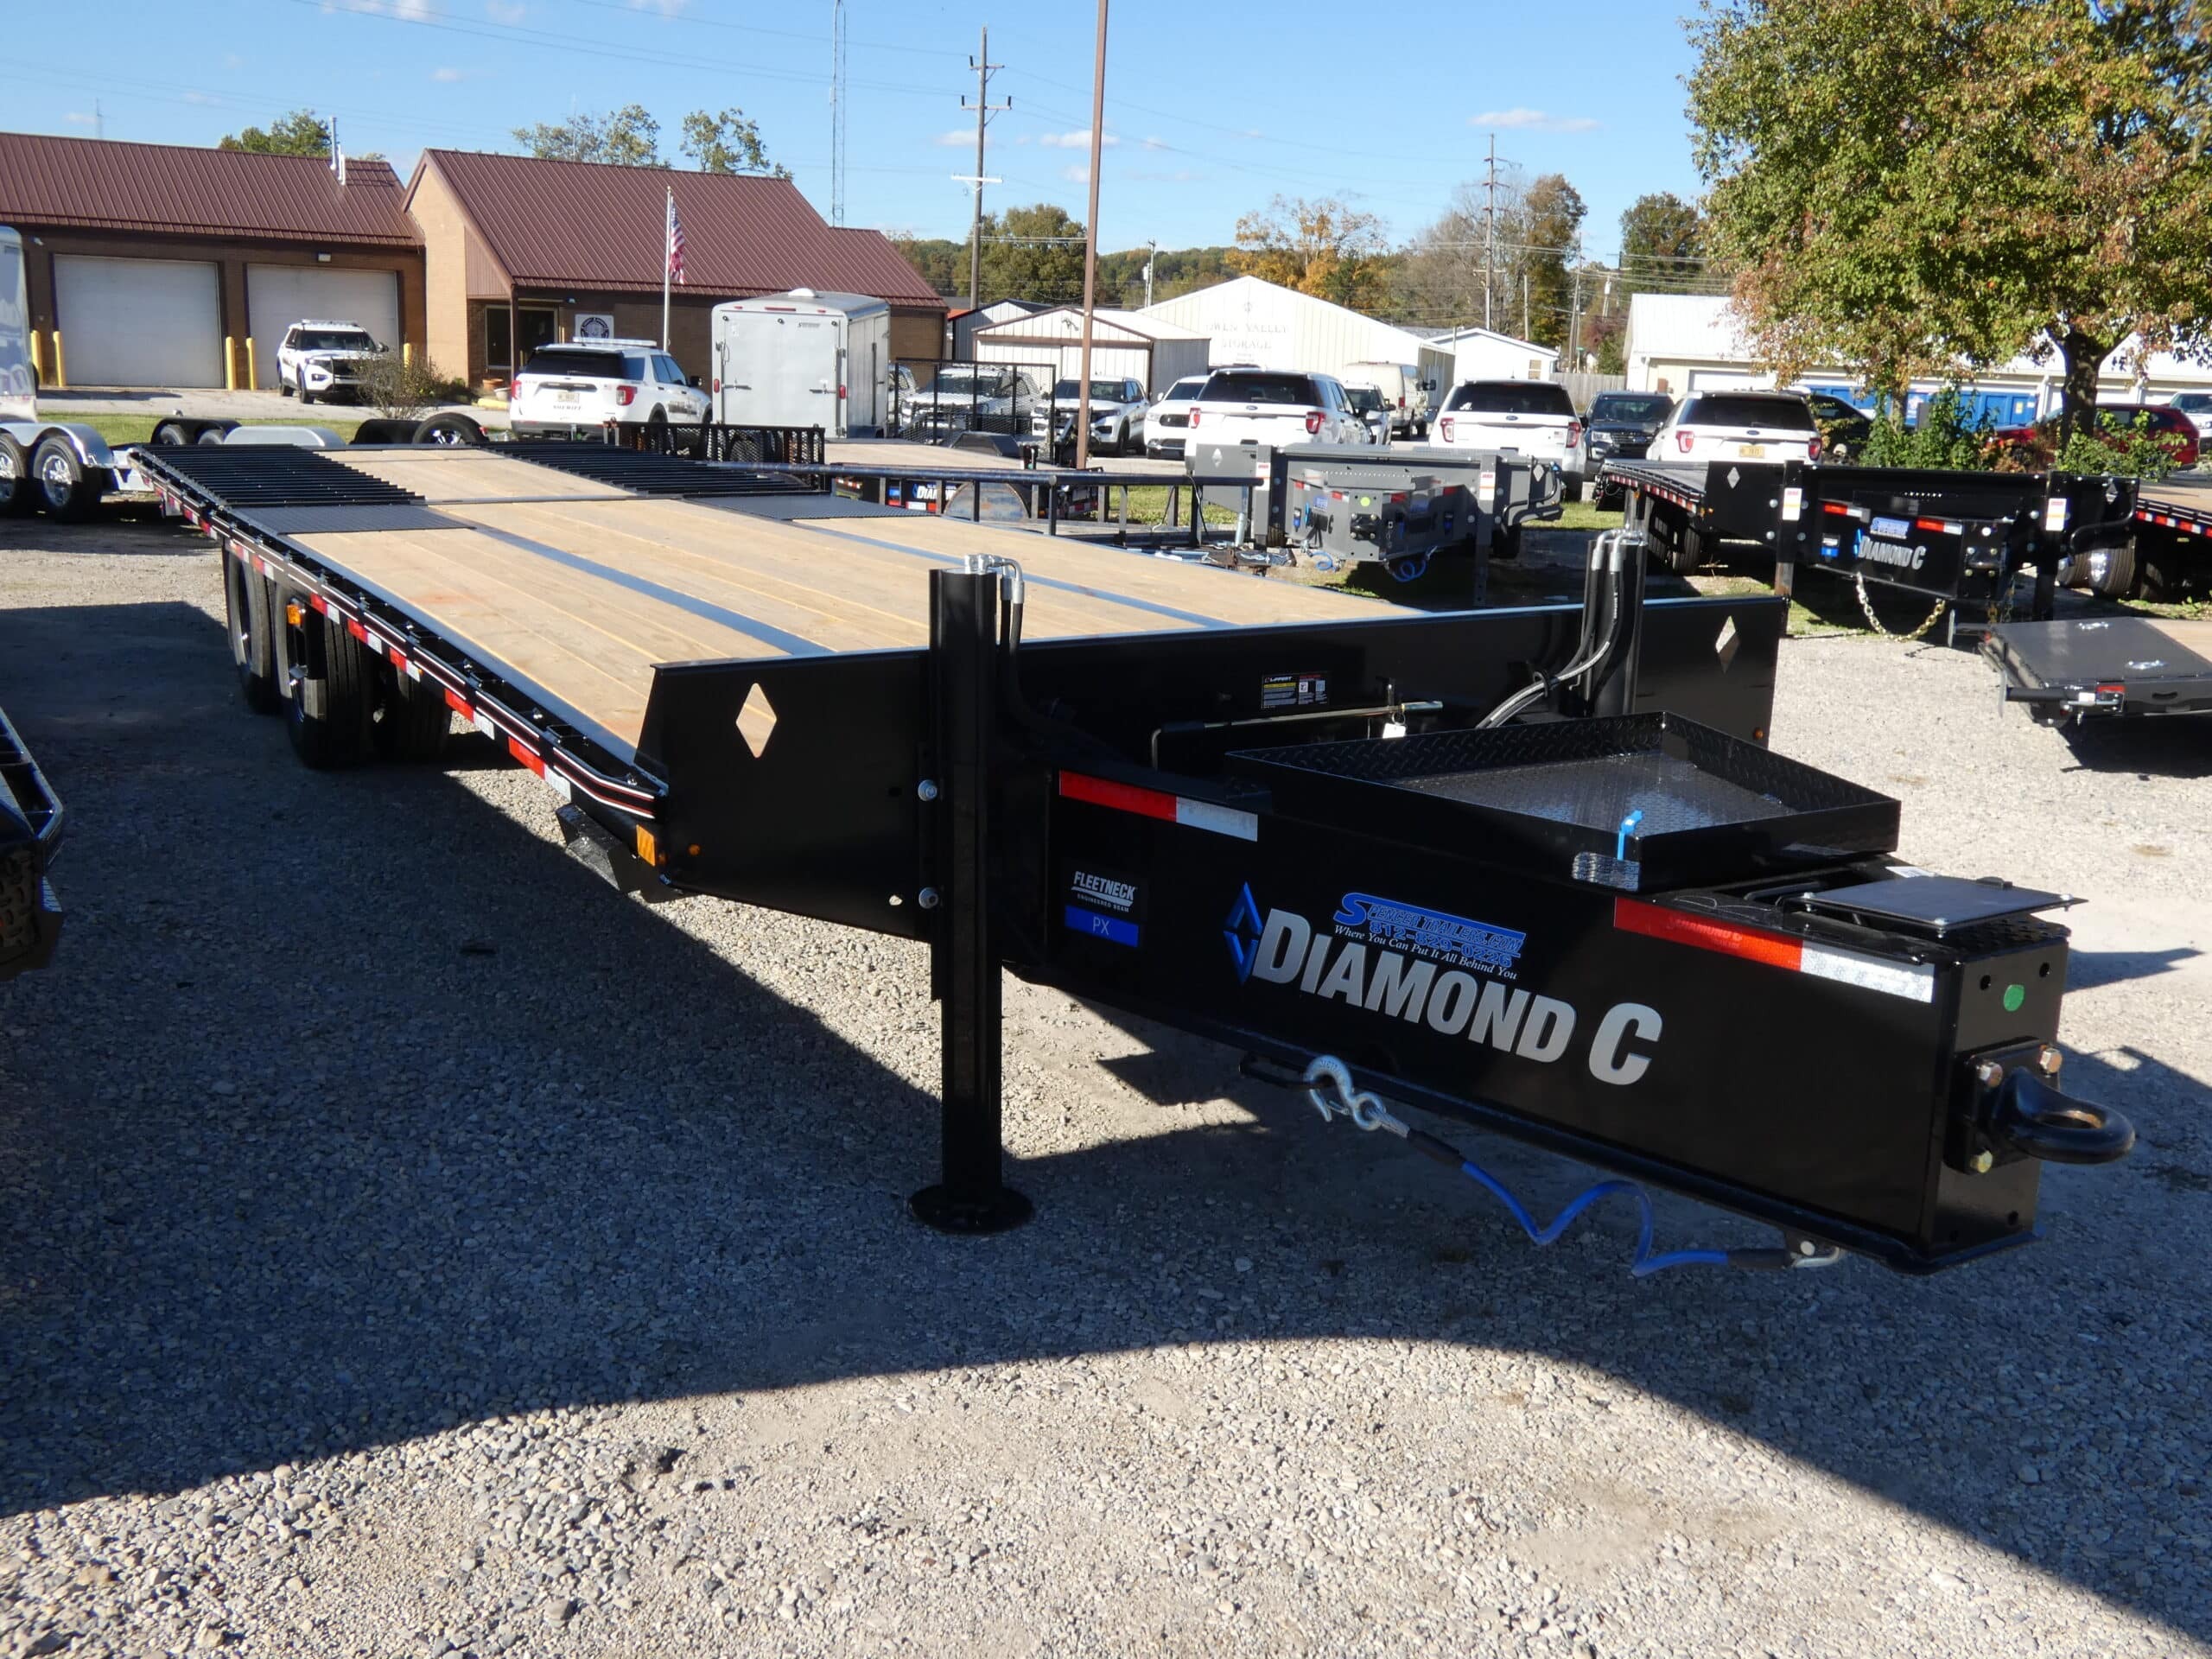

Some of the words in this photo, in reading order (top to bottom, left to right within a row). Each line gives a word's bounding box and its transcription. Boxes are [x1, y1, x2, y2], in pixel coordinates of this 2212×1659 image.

[1859, 536, 1912, 567] DIAMOND
[1911, 545, 1927, 570] C
[1073, 871, 1135, 899] FLEETNECK
[1092, 915, 1109, 936] PX
[1332, 892, 1422, 927] SPENCER
[1333, 925, 1366, 940] Where
[1368, 932, 1386, 945] You
[1389, 938, 1408, 951] Can
[1410, 943, 1429, 957] Put
[1431, 947, 1440, 958] It
[1440, 951, 1457, 964] All
[1459, 956, 1495, 974] Behind
[1497, 967, 1518, 981] You
[1369, 921, 1512, 968] 812-829-0226
[1252, 907, 1577, 1064] DIAMOND
[1588, 1002, 1663, 1086] C
